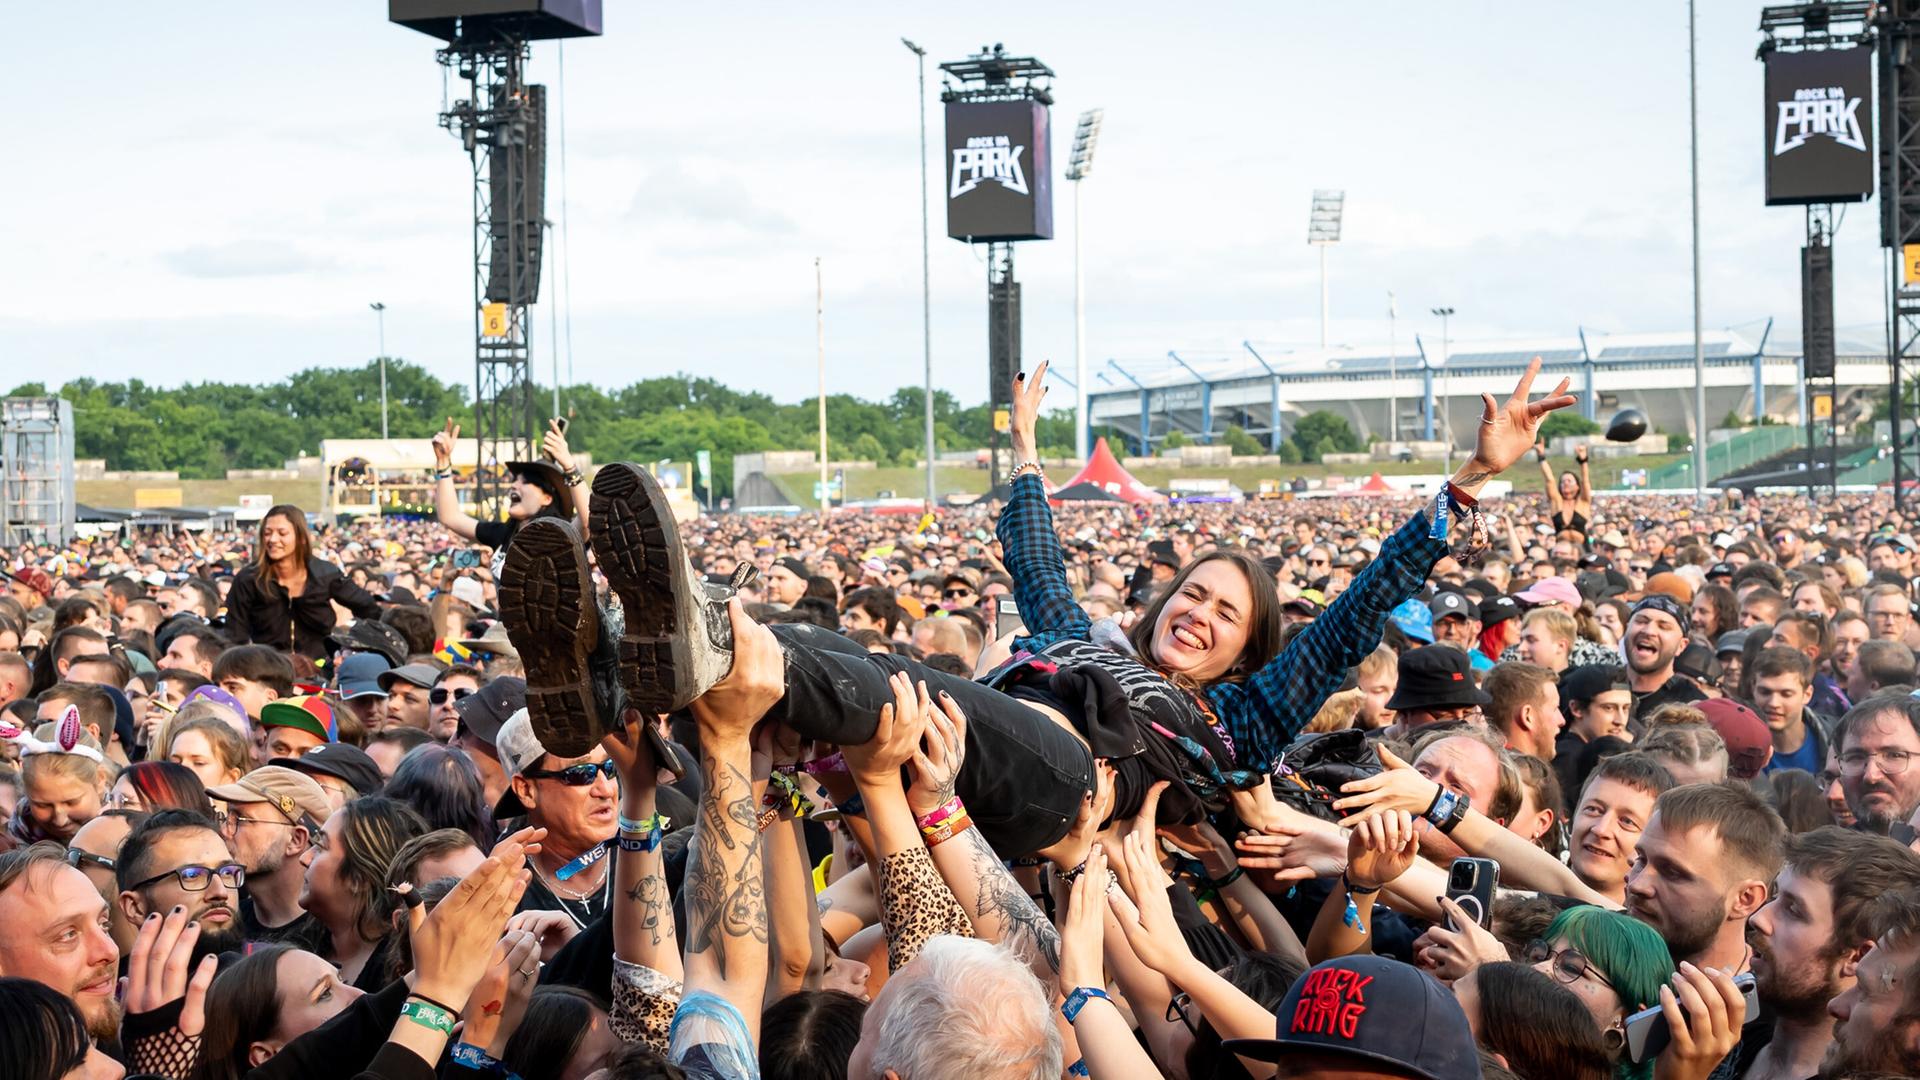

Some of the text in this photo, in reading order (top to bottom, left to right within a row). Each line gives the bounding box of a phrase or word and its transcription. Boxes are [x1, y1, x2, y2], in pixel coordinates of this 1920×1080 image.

[1794, 86, 1845, 101] ROCK IM
[1774, 97, 1867, 156] PARK
[950, 145, 1030, 199] PARK
[490, 317, 498, 330] 6
[1302, 967, 1374, 1003] ROCK
[1291, 998, 1367, 1039] RING
